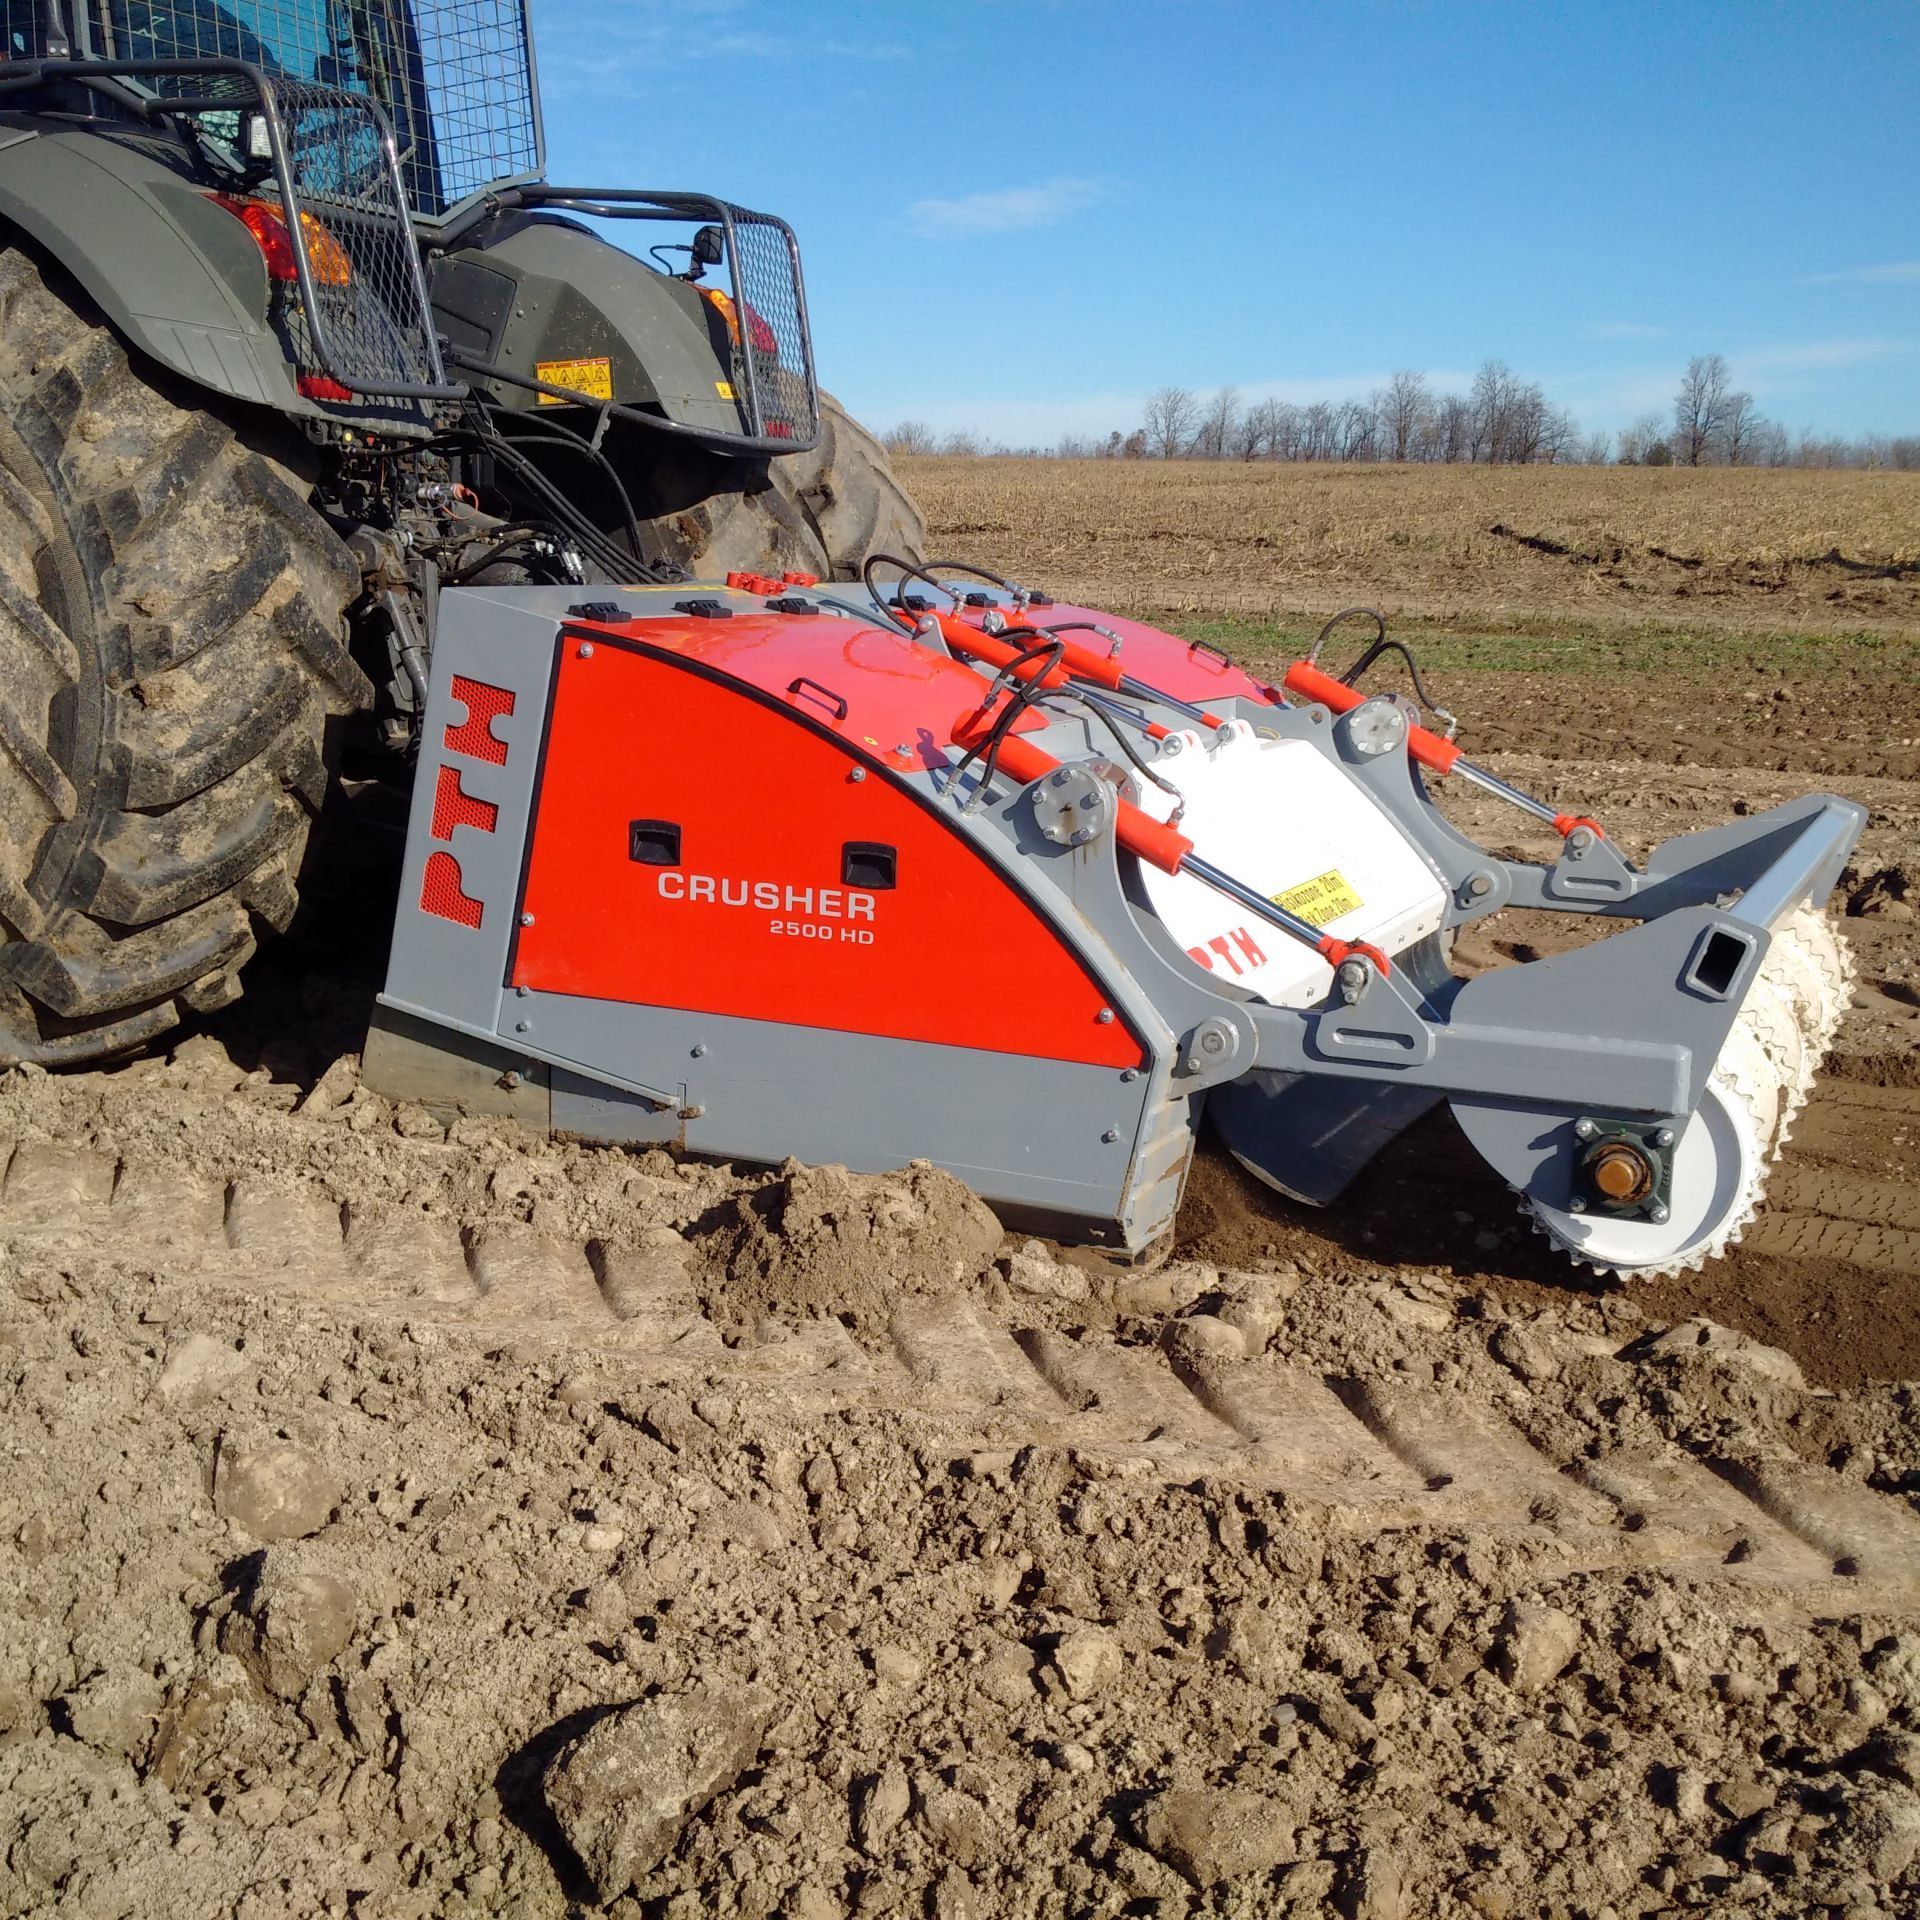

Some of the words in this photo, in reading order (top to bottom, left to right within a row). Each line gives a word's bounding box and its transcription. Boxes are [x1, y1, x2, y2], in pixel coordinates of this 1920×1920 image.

[419, 674, 516, 930] PTH
[658, 872, 876, 921] CRUSHER
[1318, 876, 1345, 893] 20m
[1312, 905, 1338, 923] Zone
[1331, 897, 1354, 914] 20m
[770, 920, 833, 940] 2500
[840, 928, 874, 945] HD
